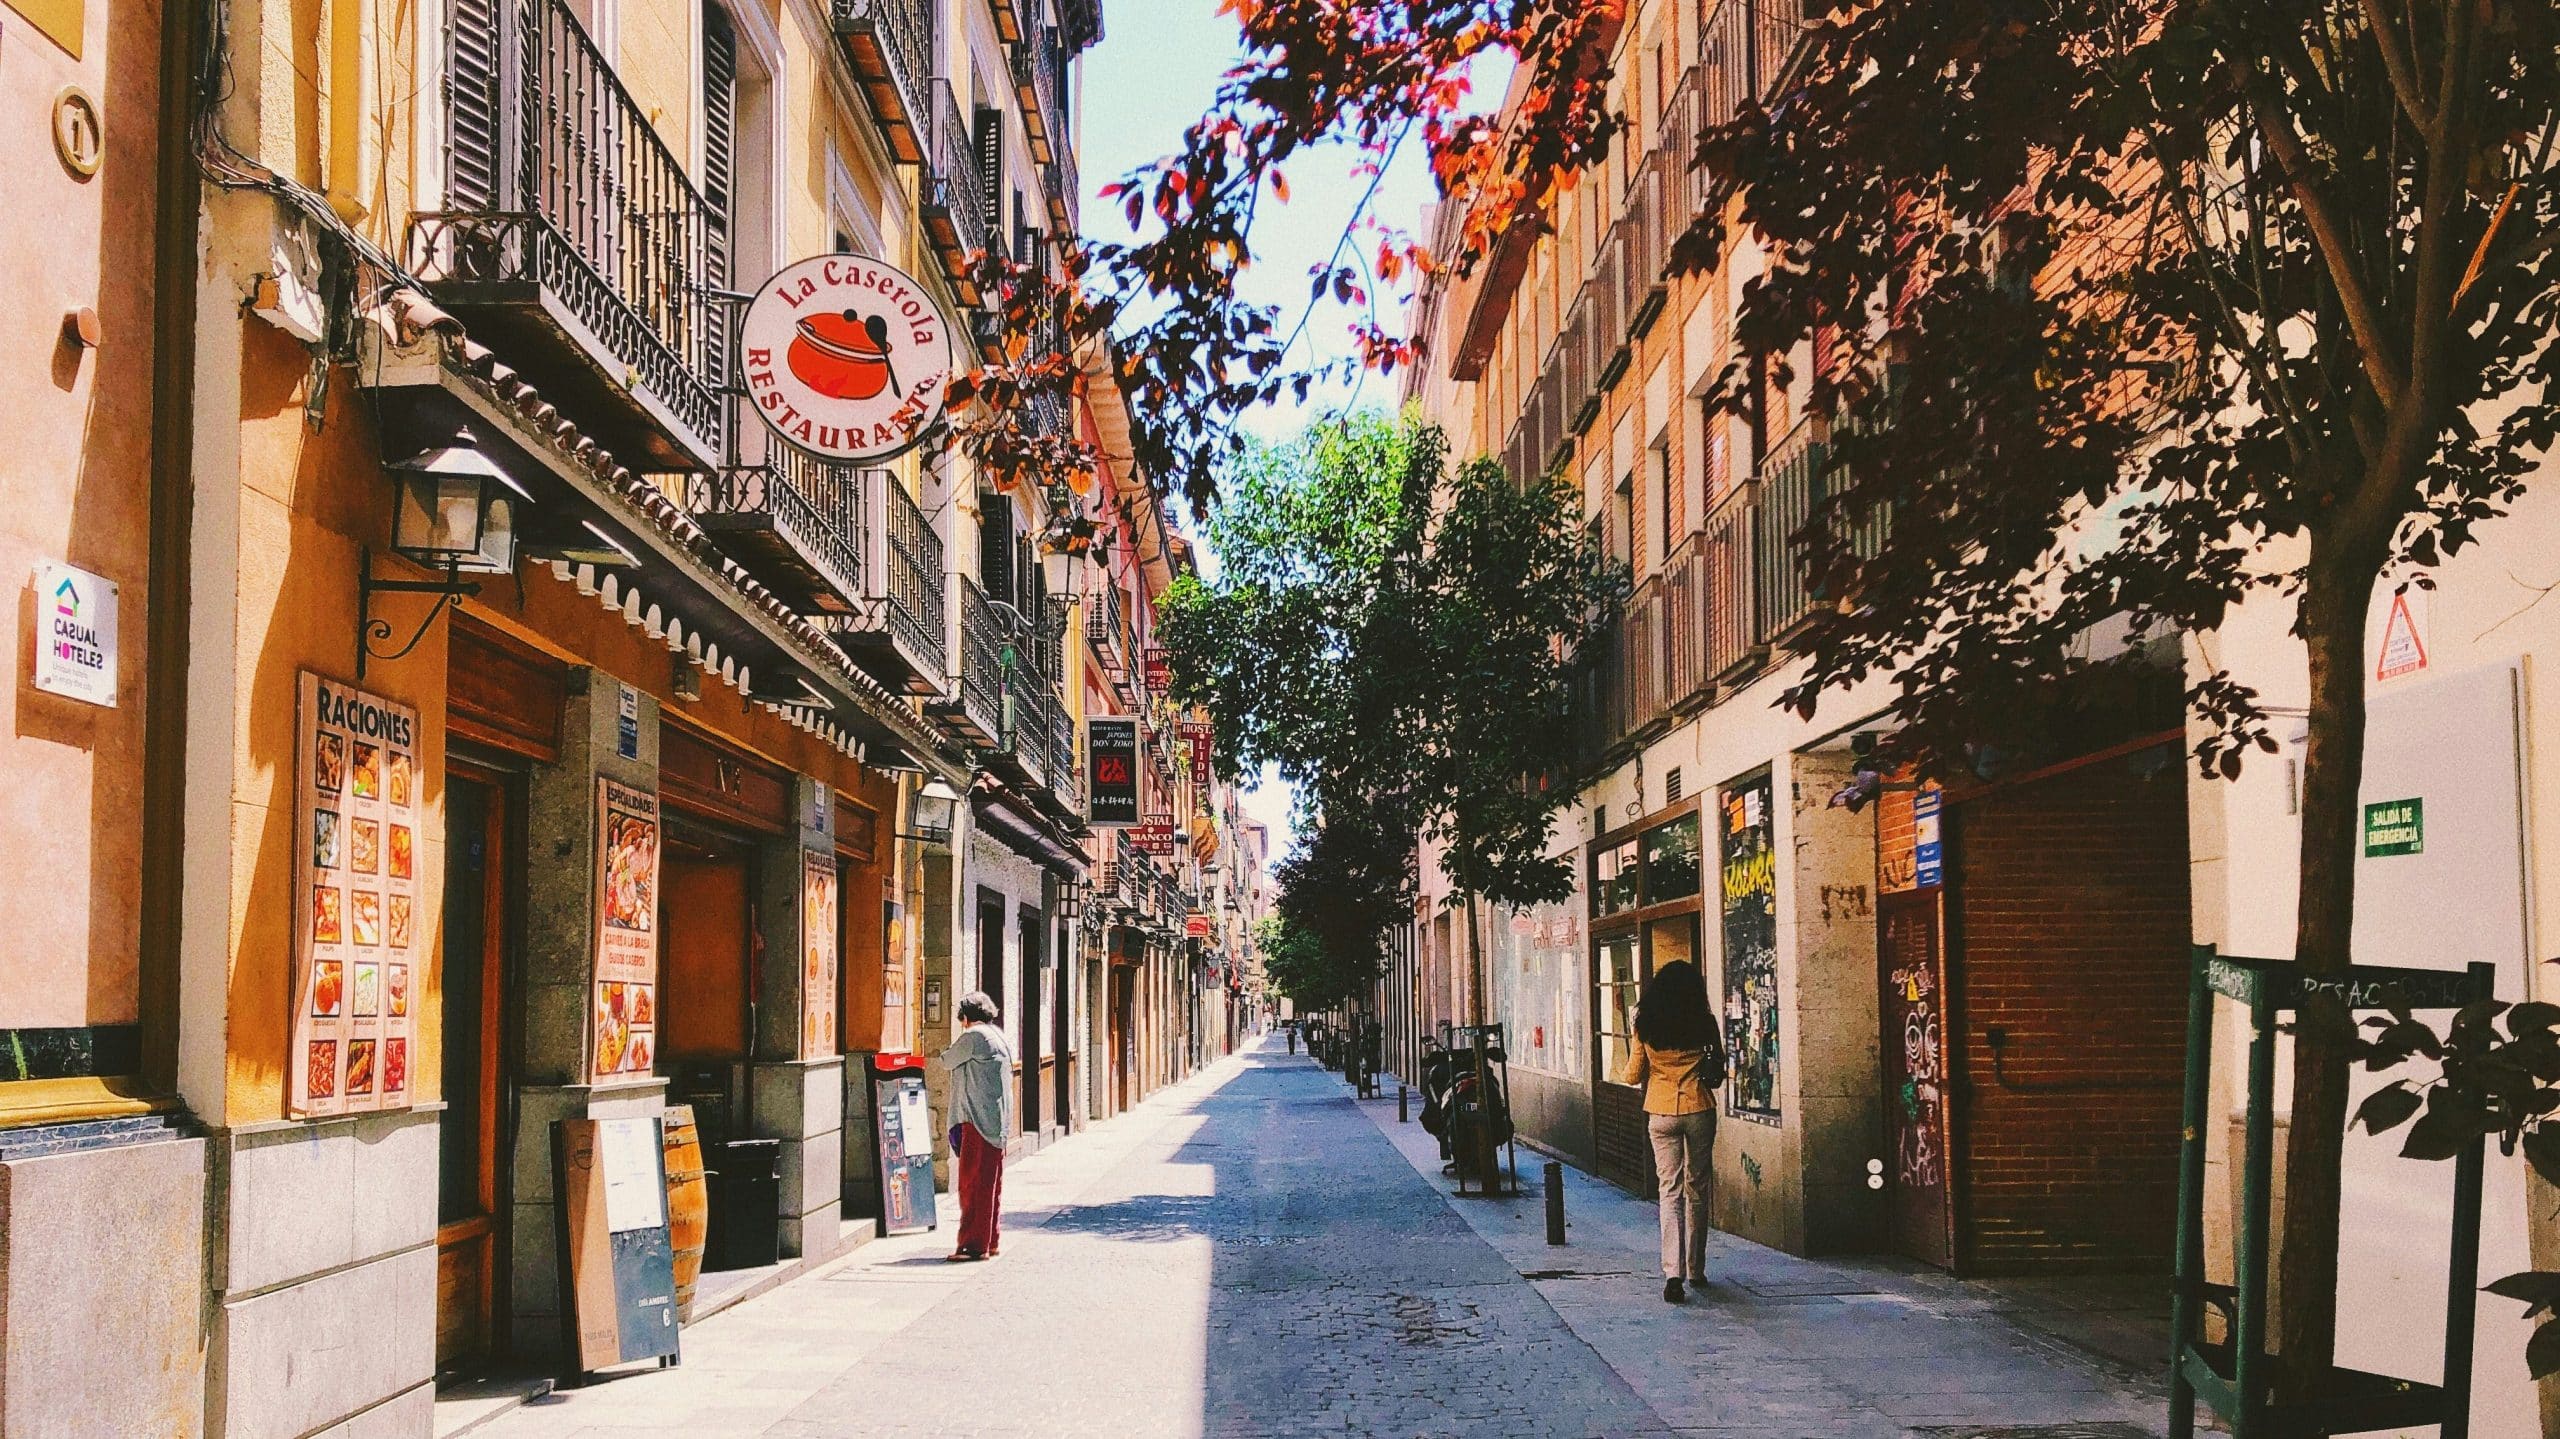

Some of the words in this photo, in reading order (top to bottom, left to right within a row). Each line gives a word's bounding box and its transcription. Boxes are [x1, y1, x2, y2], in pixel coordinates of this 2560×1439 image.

[776, 277, 818, 309] La
[823, 260, 936, 346] Caserola
[54, 618, 98, 647] CASUAL
[54, 639, 103, 670] HOTELES
[318, 685, 411, 747] RACIONES
[1093, 739, 1109, 747] DON
[1196, 740, 1206, 782] LIDO
[2372, 807, 2400, 826] SALIDA
[2402, 806, 2413, 823] DE
[2368, 827, 2418, 846] EMERGENCIA
